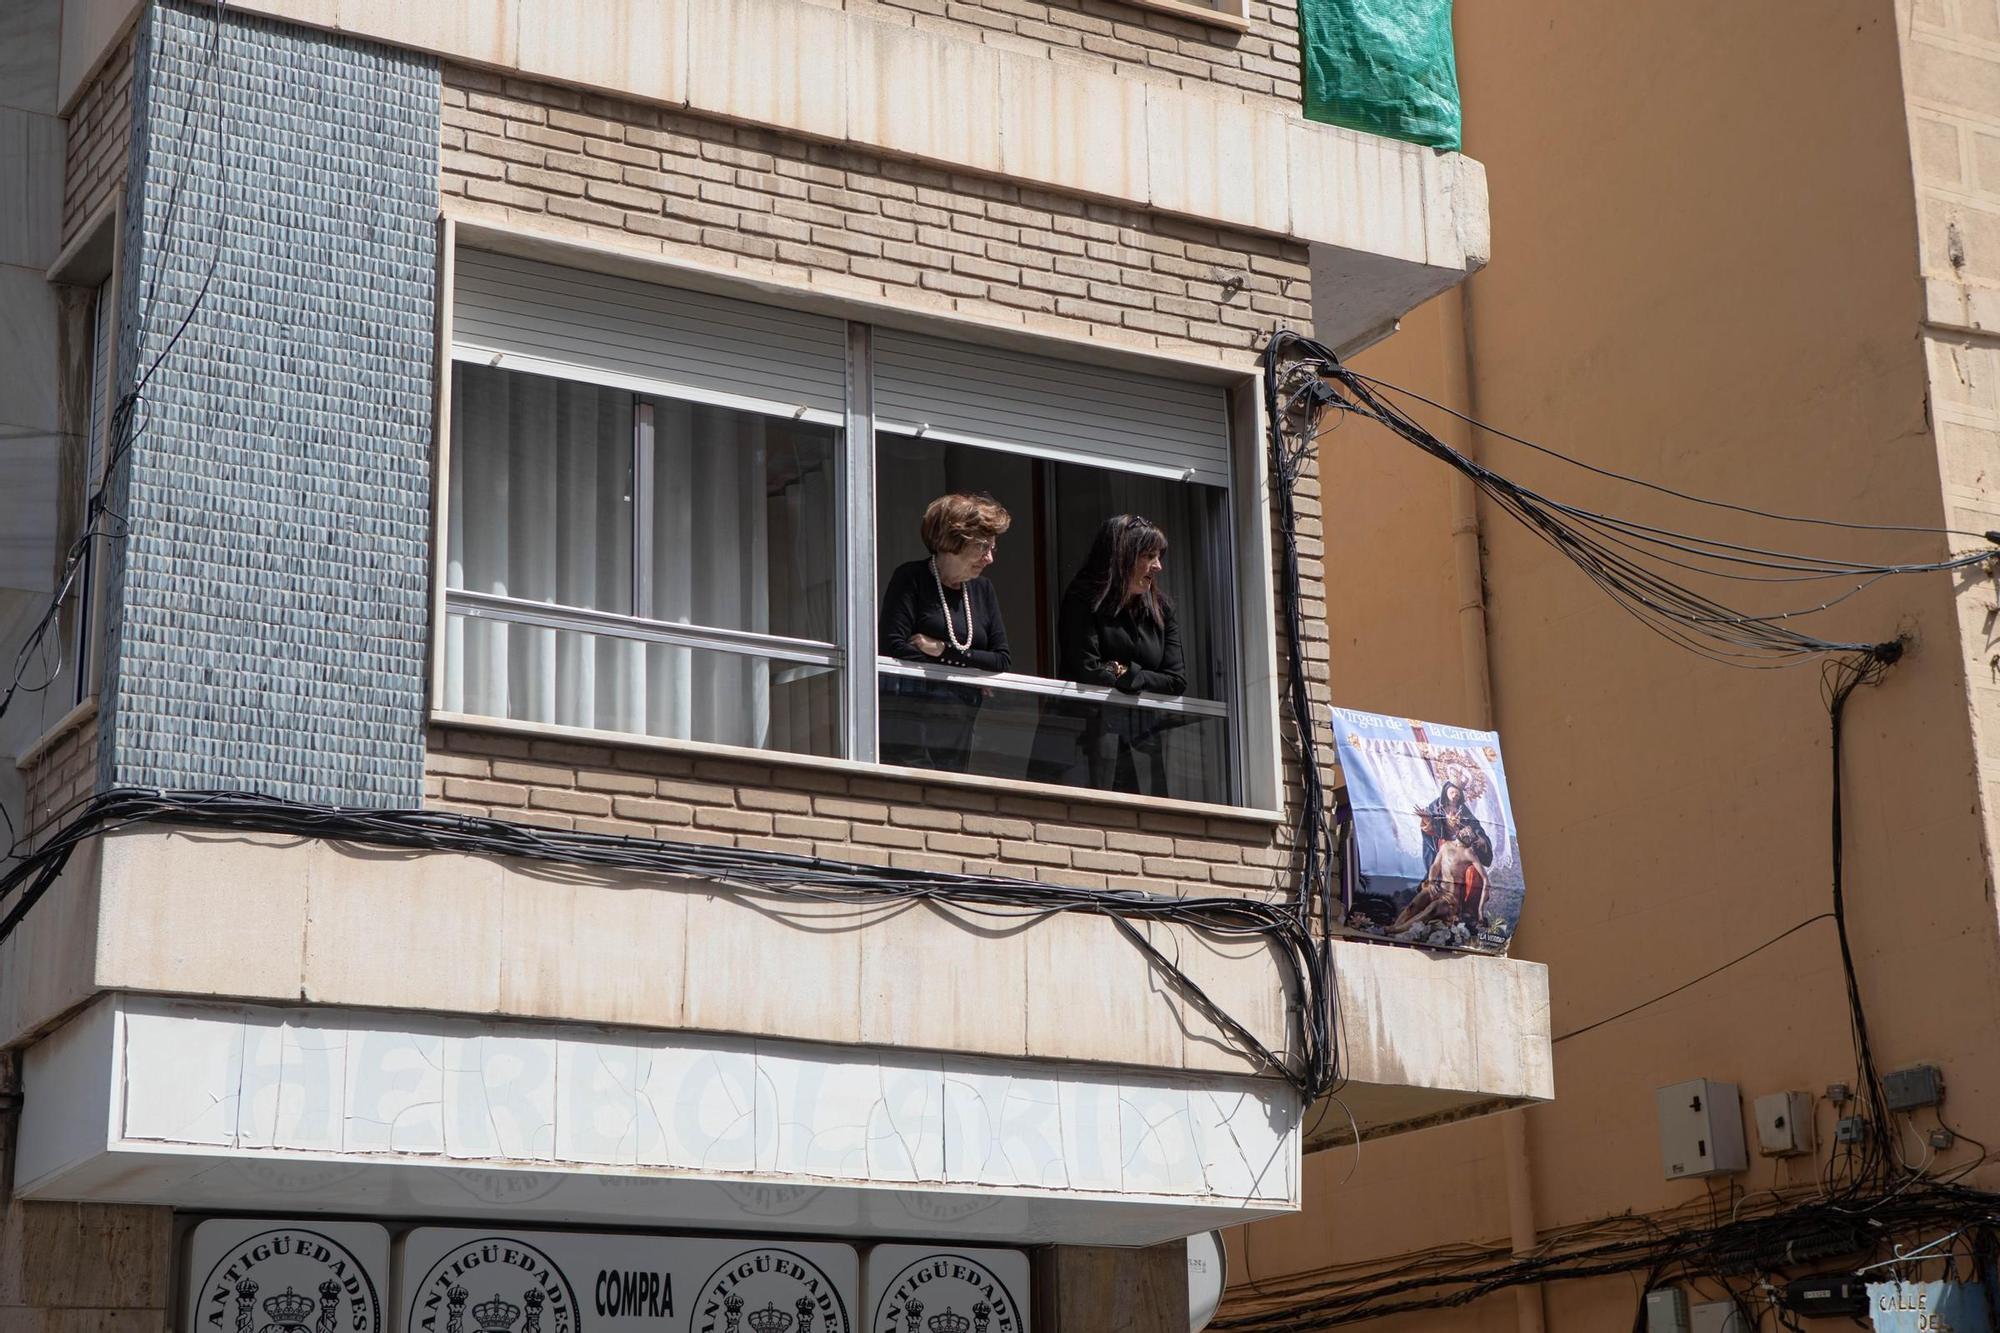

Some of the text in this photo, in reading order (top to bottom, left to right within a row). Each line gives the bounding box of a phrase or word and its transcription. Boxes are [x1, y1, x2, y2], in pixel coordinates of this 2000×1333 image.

[1333, 708, 1384, 729] Virgen
[1386, 717, 1402, 730] de
[208, 1235, 368, 1331] ANTIGÜEDADES
[595, 1269, 674, 1318] COMPRA
[1879, 1294, 1926, 1311] CALLE
